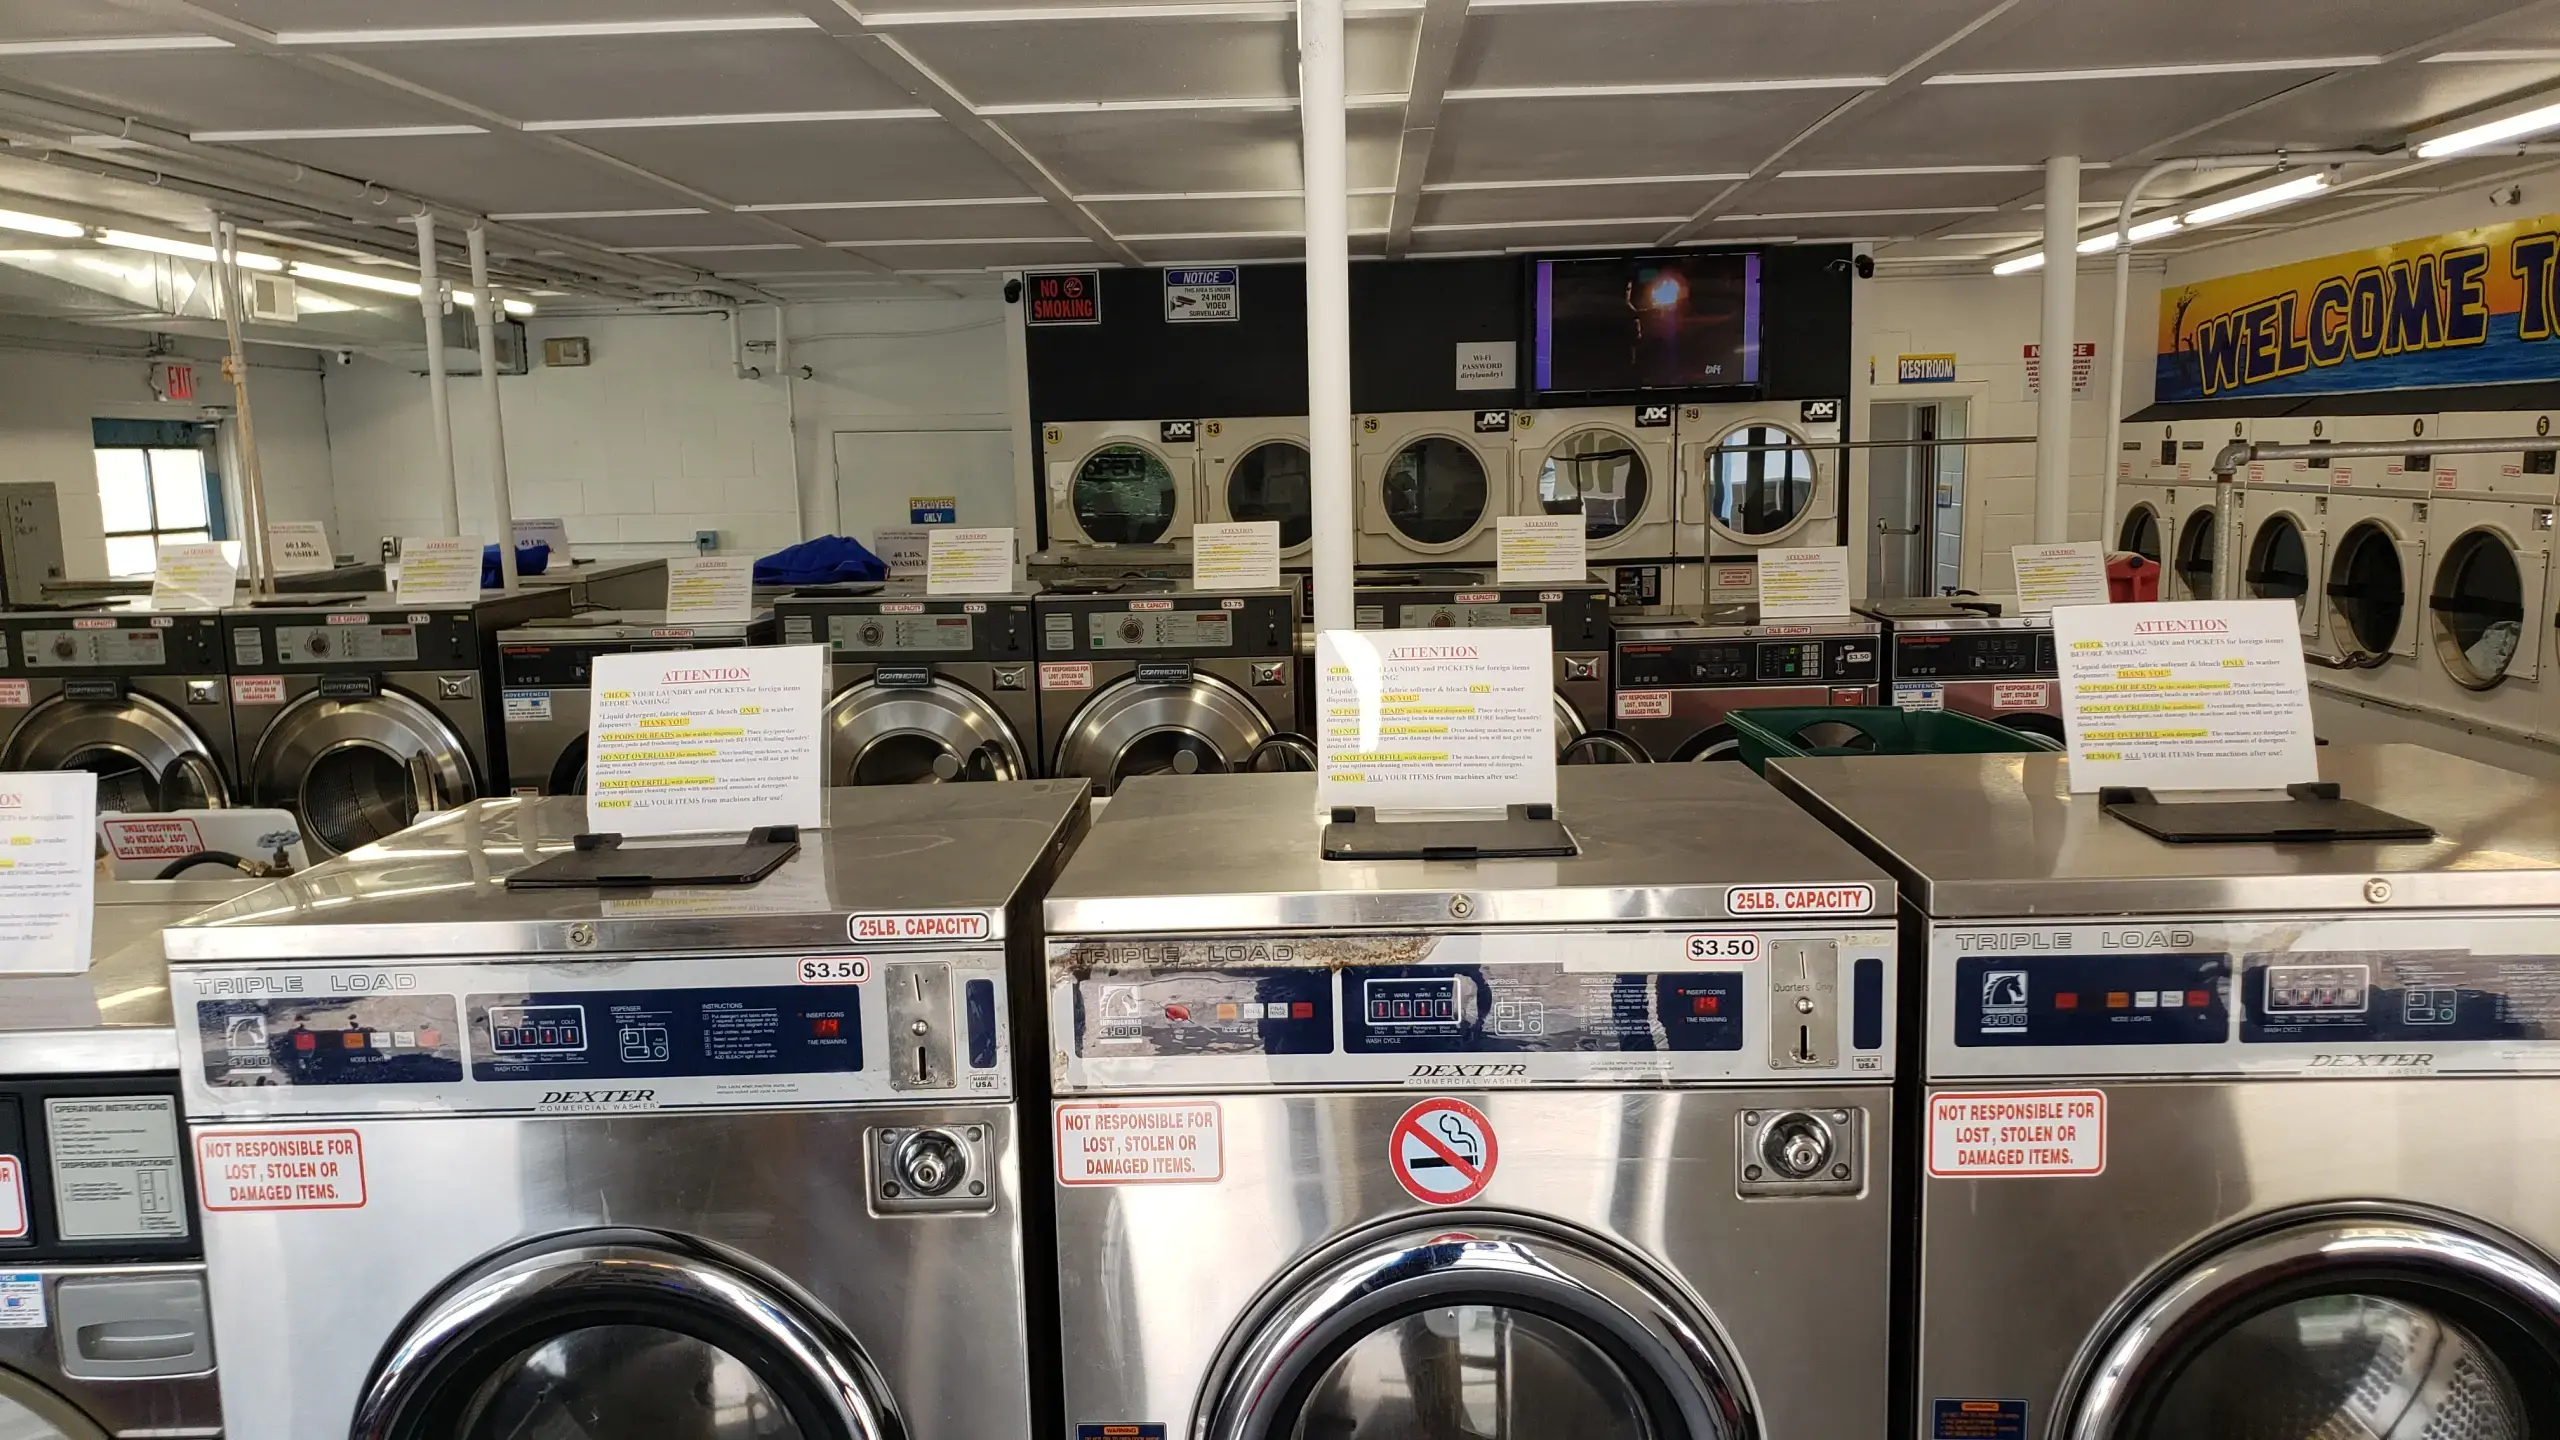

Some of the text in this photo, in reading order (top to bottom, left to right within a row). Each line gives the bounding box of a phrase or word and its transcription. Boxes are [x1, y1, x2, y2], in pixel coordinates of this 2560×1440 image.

[1184, 272, 1219, 283] NOTICE
[1041, 279, 1058, 298] NO
[1035, 300, 1092, 319] SMOKING
[2198, 245, 2490, 396] WELCOME
[1901, 359, 1953, 379] RESTROOM
[167, 367, 193, 398] EXIT
[1645, 407, 1667, 419] ADC
[1810, 403, 1833, 414] ADC
[1484, 413, 1505, 424] ADC
[2540, 418, 2546, 434] 5
[1169, 423, 1191, 434] ADC
[2415, 420, 2422, 435] 4
[912, 500, 953, 509] EMPLOYEES
[924, 513, 942, 522] ONLY
[285, 550, 320, 558] WASHER
[1785, 553, 1820, 561] ATTENTION
[1474, 593, 1496, 601] CAPACITY
[2134, 619, 2228, 634] ATTENTION
[1388, 646, 1479, 661] ATTENTION
[662, 668, 750, 683] ATTENTION
[1737, 891, 1862, 909] 25LB. CAPACITY
[859, 918, 979, 935] 25LB. CAPACITY
[1955, 930, 2194, 950] TRIPLE LOAD
[1071, 945, 1294, 965] TRIPLE LOAD
[1691, 940, 1754, 956] $3.50
[804, 962, 864, 979] $3.50
[194, 973, 417, 994] TRIPLE LOAD
[1774, 983, 1810, 993] Quarters
[1981, 1014, 2028, 1025] 400
[1100, 1026, 1142, 1036] 400
[2307, 1054, 2435, 1067] DEXTER
[1409, 1065, 1527, 1076] DEXTER
[539, 1090, 655, 1104] DEXTER
[54, 1103, 168, 1113] OPERATING INSTRUCTIONS
[540, 1102, 656, 1112] COMMERCIAL WASHER
[1939, 1102, 2094, 1120] NOT RESPONSIBLE FOR
[1065, 1112, 1213, 1130] NOT RESPONSIBLE FOR
[2000, 1126, 2053, 1142] STOLEN
[2057, 1126, 2076, 1141] OR
[205, 1139, 353, 1158] NOT RESPONSIBLE FOR
[1125, 1136, 1174, 1152] STOLEN
[1179, 1135, 1196, 1150] OR
[1958, 1148, 2074, 1165] DAMAGED ITEMS.
[267, 1162, 316, 1178] STOLEN
[320, 1162, 338, 1177] OR
[1086, 1157, 1195, 1174] DAMAGED ITEMS.
[229, 1183, 339, 1201] DAMAGED ITEMS.
